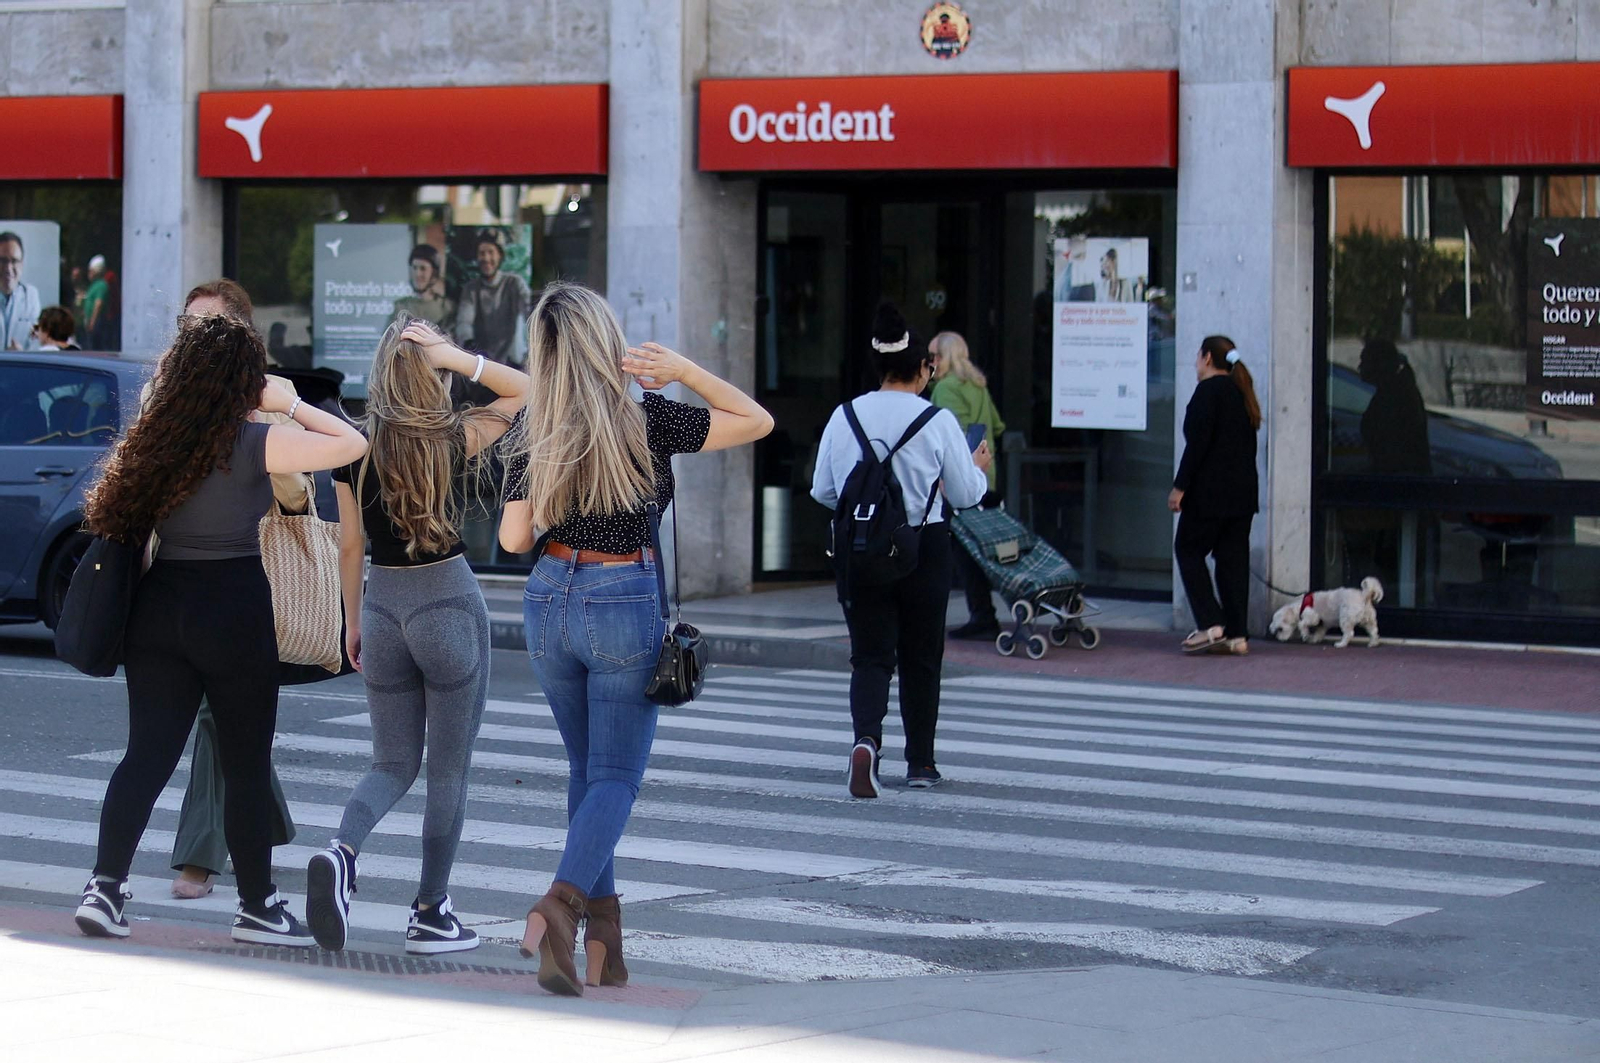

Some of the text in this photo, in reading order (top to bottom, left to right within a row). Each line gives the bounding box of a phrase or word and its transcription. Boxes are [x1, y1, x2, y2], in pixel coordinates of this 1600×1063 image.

[729, 101, 895, 143] Occident
[324, 300, 395, 318] todo y todo
[1543, 304, 1581, 324] todo
[1584, 308, 1596, 327] y
[1541, 390, 1595, 405] Occident
